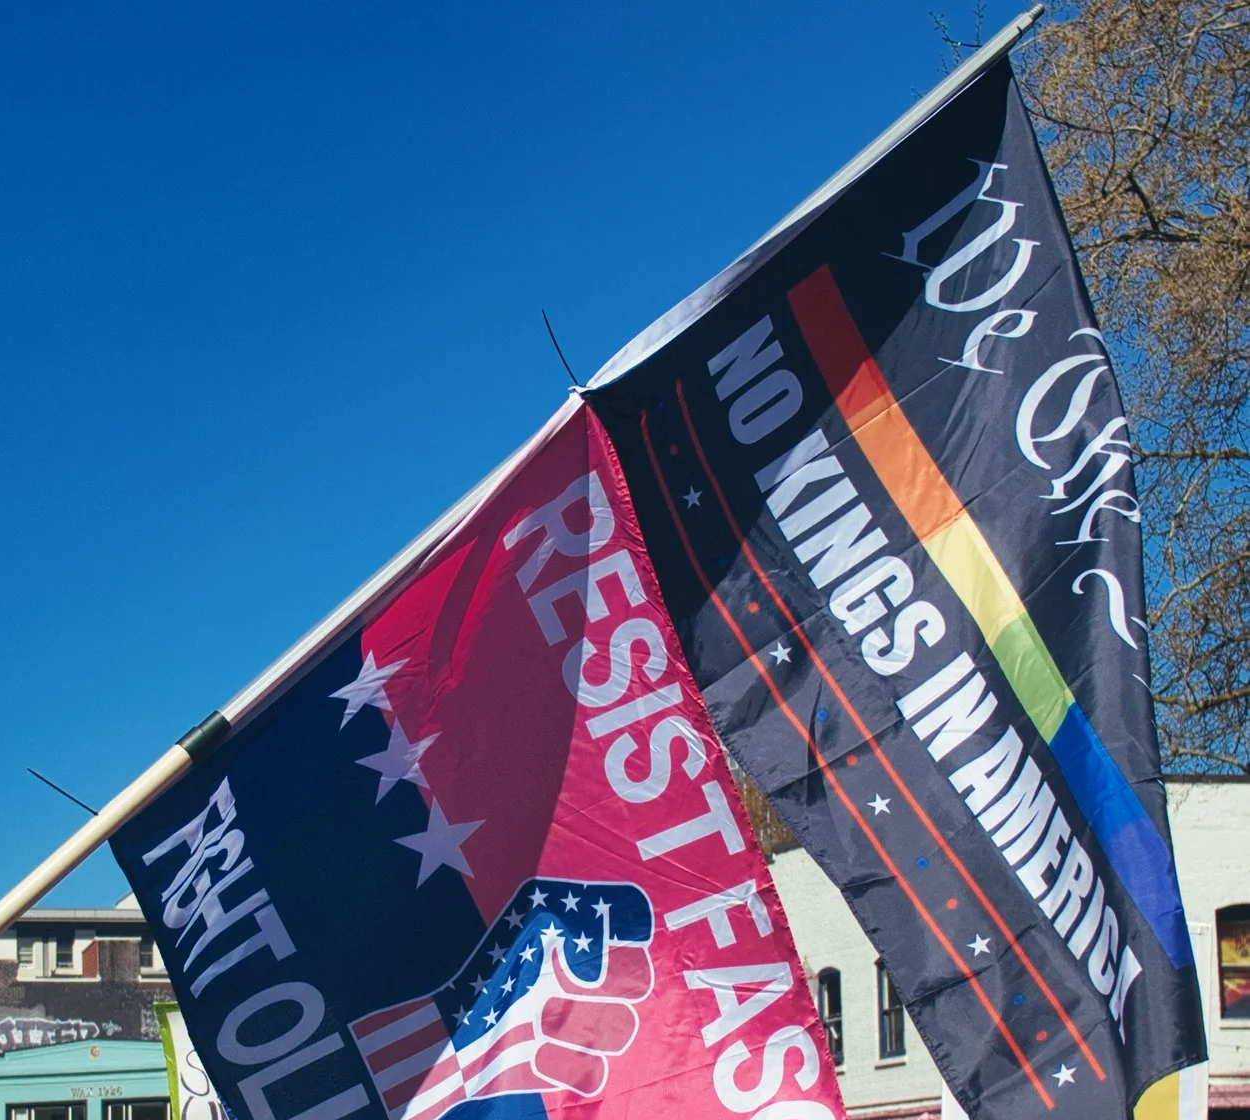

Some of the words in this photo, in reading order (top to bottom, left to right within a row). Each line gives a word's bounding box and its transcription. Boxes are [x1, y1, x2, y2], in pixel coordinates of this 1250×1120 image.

[707, 314, 803, 445] NO
[503, 470, 747, 862] RESIST
[754, 428, 946, 677] KINGS
[896, 651, 998, 763] IN
[141, 775, 298, 996] FIGHT
[950, 723, 1143, 1045] AMERICA
